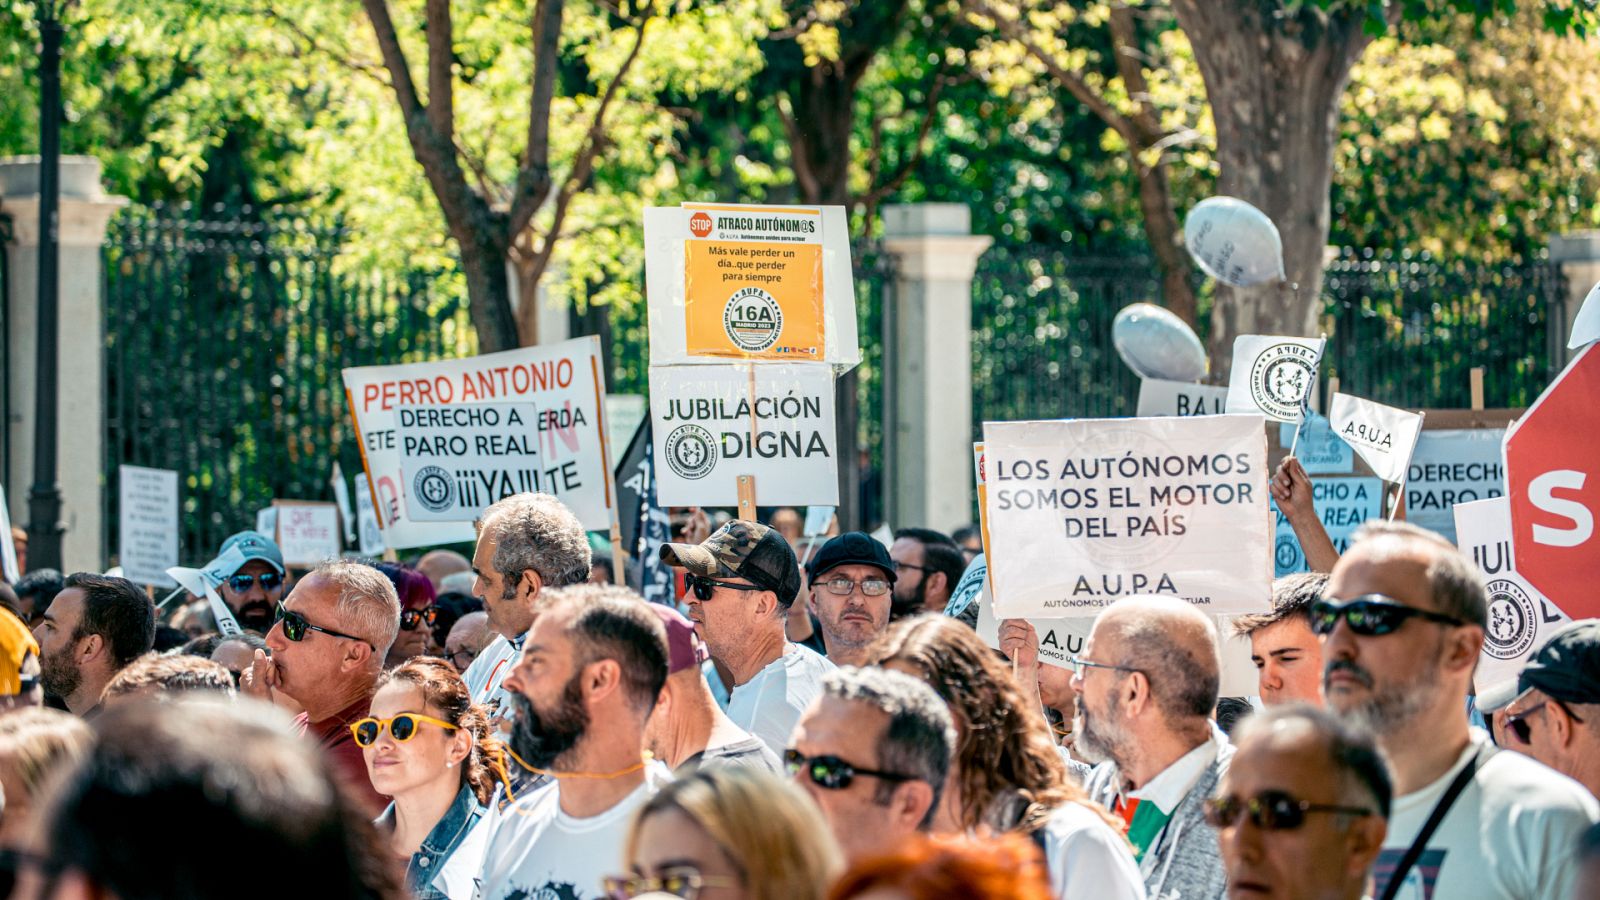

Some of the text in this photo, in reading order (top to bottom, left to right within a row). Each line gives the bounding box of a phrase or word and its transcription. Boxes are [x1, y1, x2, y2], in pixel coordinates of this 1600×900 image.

[690, 218, 711, 230] STOP
[718, 216, 815, 233] ATRACO AUTÓNOM@S
[708, 246, 795, 260] Más vale perder un
[756, 260, 787, 272] perder
[722, 273, 782, 284] para siempre
[741, 287, 764, 297] AUPA
[734, 305, 773, 321] 16A
[364, 358, 573, 412] PERRO ANTONIO
[663, 390, 821, 421] JUBILACIÓN
[401, 407, 524, 428] DERECHO A
[405, 434, 537, 457] PARO REAL
[721, 430, 830, 459] DIGNA
[997, 459, 1050, 481] LOS
[1060, 451, 1251, 481] AUTÓNOMOS
[1408, 462, 1504, 482] DERECH
[997, 483, 1254, 510] SOMOS EL MOTOR
[1354, 483, 1368, 500] A
[1527, 469, 1595, 548] S
[1065, 509, 1187, 538] DEL PAÍS
[1043, 597, 1104, 608] AUTÓNOMOS
